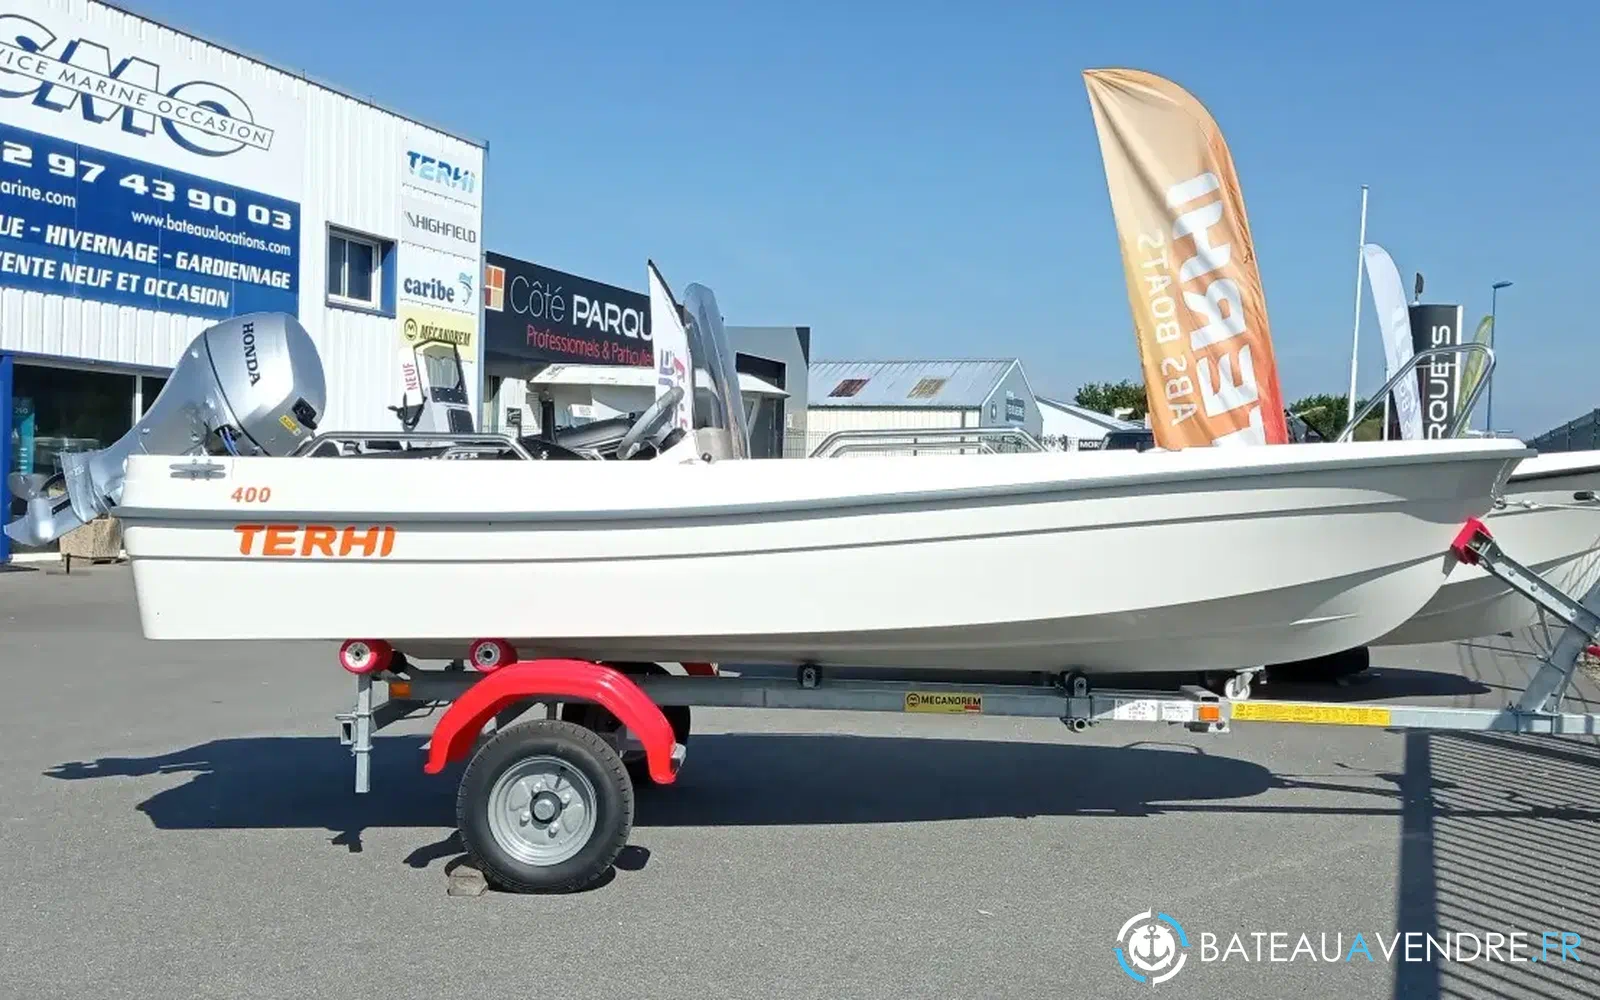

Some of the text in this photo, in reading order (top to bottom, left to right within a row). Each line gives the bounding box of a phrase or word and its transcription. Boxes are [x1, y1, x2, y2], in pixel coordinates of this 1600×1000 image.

[58, 68, 148, 107] MARINE
[157, 100, 266, 145] OCCASION
[2, 140, 292, 231] 2 97 43 90 03
[407, 150, 476, 193] TERHI
[0, 178, 77, 208] arine.com
[131, 210, 292, 257] www.bateauxlocations.com
[416, 214, 476, 243] HIGHFIELD
[45, 224, 158, 264] HIVERNAGE
[175, 252, 291, 290] GARDIENNAGE
[0, 250, 230, 309] ENTE NEUF ET OCCASION
[404, 277, 455, 302] caribe
[510, 275, 566, 323] Côté
[242, 322, 261, 387] HONDA
[526, 324, 600, 358] Professionnels
[601, 340, 610, 360] &
[403, 362, 418, 391] NEUF
[231, 487, 271, 502] 400
[234, 525, 395, 556] TERHI
[921, 695, 981, 705] MECANOREM
